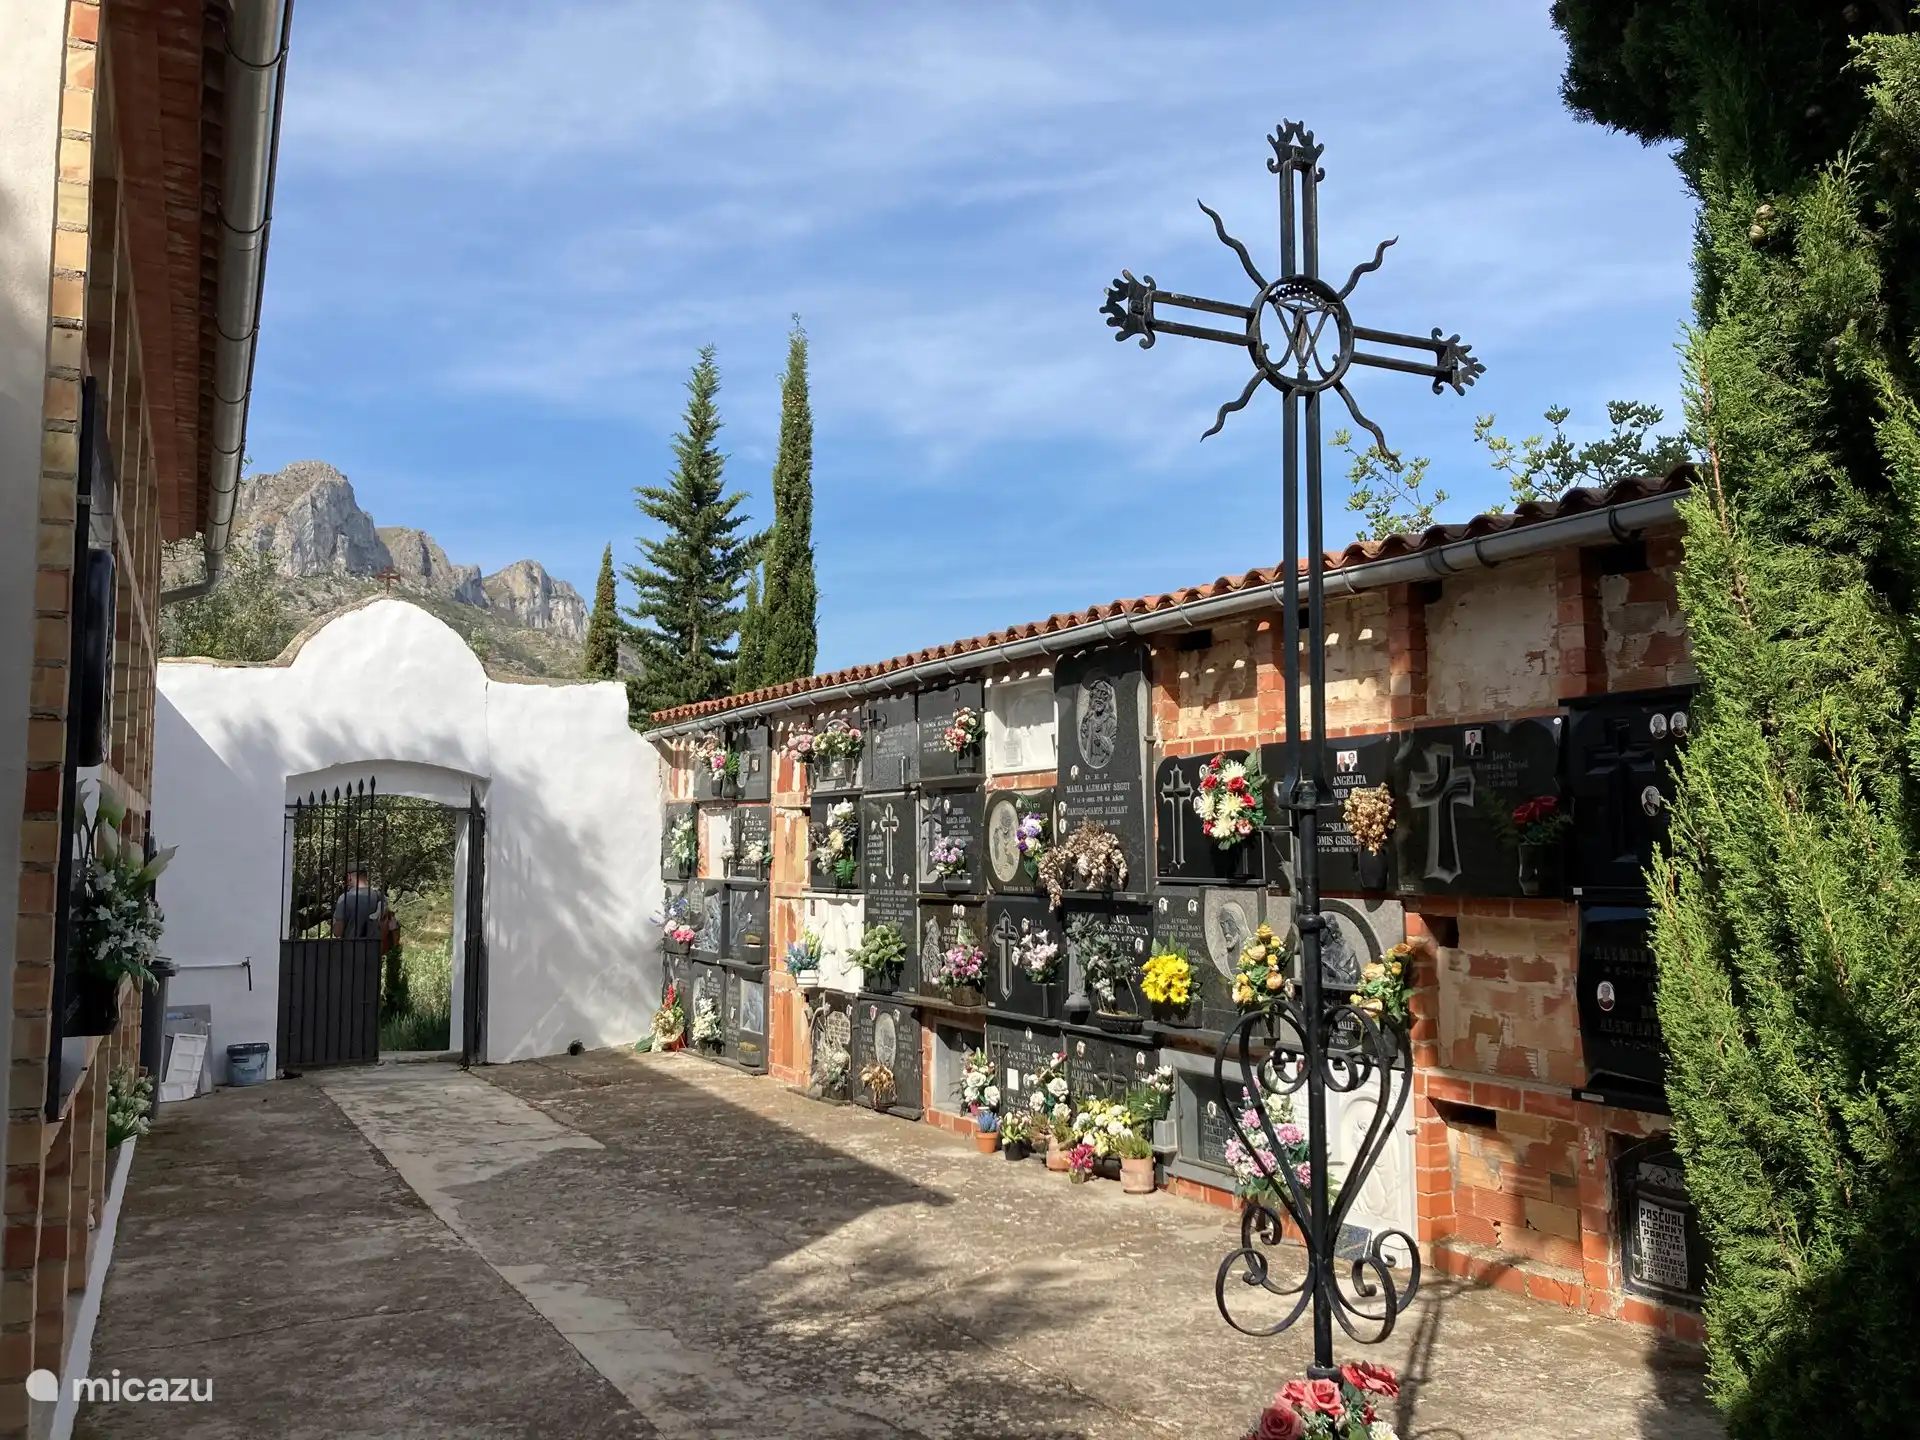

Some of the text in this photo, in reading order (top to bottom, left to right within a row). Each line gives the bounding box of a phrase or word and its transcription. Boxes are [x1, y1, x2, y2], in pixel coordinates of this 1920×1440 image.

[1332, 775, 1367, 785] ANGELITA
[1066, 785, 1084, 793] MARIA
[1085, 783, 1111, 792] ALEMANY
[1316, 835, 1334, 846] OMIS
[1641, 1208, 1684, 1227] PASCUAL
